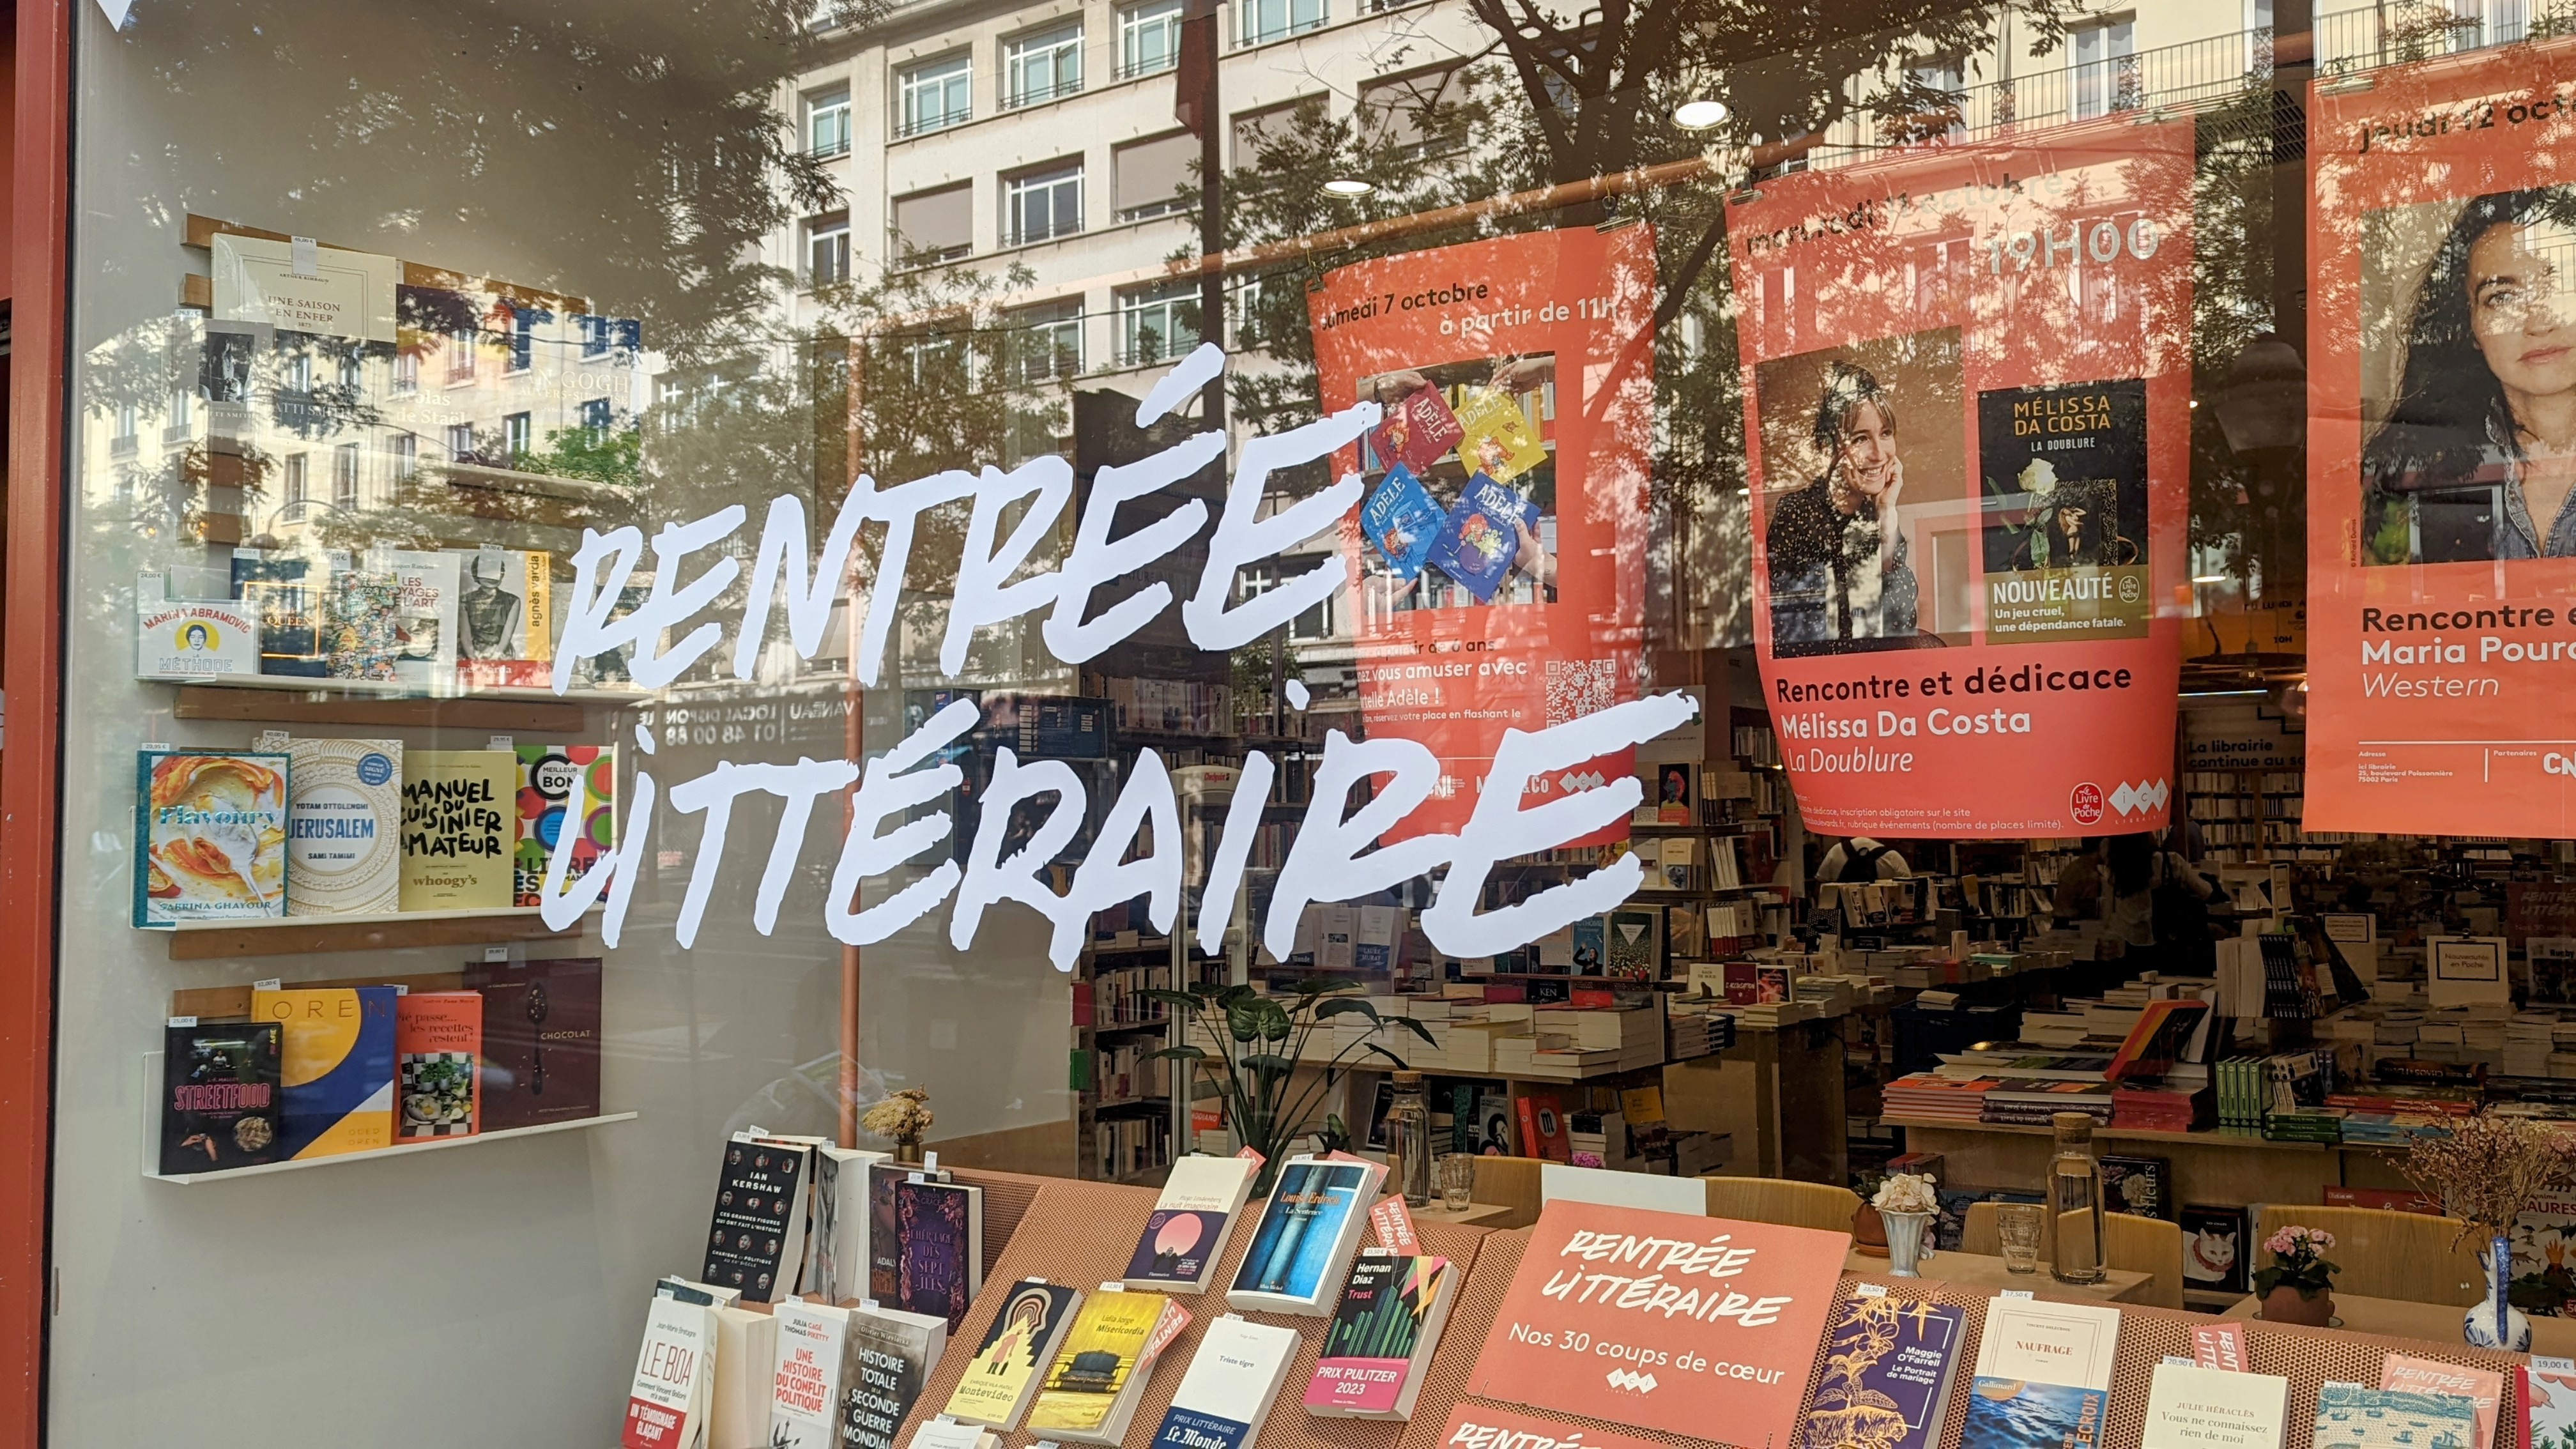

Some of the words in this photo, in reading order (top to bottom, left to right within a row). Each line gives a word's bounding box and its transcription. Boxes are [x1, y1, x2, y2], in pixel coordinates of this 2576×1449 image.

[1746, 199, 1874, 256] mercredi
[1984, 218, 2159, 275] 19H00
[268, 296, 293, 306] UNE
[297, 300, 341, 312] SAISON
[1384, 293, 1395, 314] 7
[1401, 282, 1489, 311] octobre
[275, 308, 291, 318] EN
[296, 311, 333, 322] ENFER
[1439, 313, 1453, 335] à
[1461, 303, 1532, 339] partir
[1539, 300, 1569, 323] de
[1577, 296, 1618, 321] 11h
[561, 370, 630, 394] GOGH
[2014, 395, 2111, 418] MÉLISSA
[1414, 397, 1448, 443] ADÈLE
[2015, 419, 2041, 436] DA
[2048, 413, 2112, 434] COSTA
[2031, 441, 2043, 452] LA
[2047, 437, 2096, 451] DOUBLURE
[1368, 476, 1406, 526] ADÈLE
[1474, 482, 1526, 524] ADÈLE
[551, 342, 1382, 697] RENTRÉE
[402, 577, 421, 586] LES
[1993, 572, 2113, 604] NOUVEAUTÉ
[143, 608, 187, 630] MARINA
[1995, 608, 2011, 618] Un
[2012, 608, 2030, 620] jeu
[2032, 606, 2065, 618] cruel,
[2363, 605, 2555, 632] Rencontre
[1995, 623, 2017, 632] une
[2018, 618, 2090, 632] dépendance
[2092, 617, 2126, 628] fatale.
[1466, 640, 1495, 652] ans
[2363, 637, 2465, 665] Maria
[159, 656, 233, 672] MÉTHODE
[1372, 667, 1400, 681] vous
[1406, 662, 1472, 679] amuser
[1478, 661, 1528, 676] avec
[1777, 674, 1910, 703] Rencontre
[1920, 671, 1952, 696] et
[1964, 664, 2131, 694] dédicace
[2363, 672, 2499, 698] Western
[1387, 688, 1429, 707] Adèle
[1399, 712, 1420, 721] votre
[1422, 710, 1446, 721] place
[1463, 709, 1508, 719] flashant
[1512, 709, 1521, 717] le
[1781, 710, 1867, 740] Mélissa
[1877, 710, 1917, 737] Da
[1927, 708, 2031, 736] Costa
[2189, 740, 2206, 753] La
[2212, 739, 2273, 752] librairie
[1788, 749, 1805, 772] La
[1810, 747, 1913, 773] Doublure
[2189, 755, 2259, 767] continue
[2264, 756, 2284, 766] au
[443, 800, 464, 814] DU
[1880, 808, 1924, 818] obligatoire
[2074, 808, 2100, 818] Poche
[289, 818, 374, 839] JERUSALEM
[1879, 820, 1931, 829] événements
[1933, 820, 1972, 831] (nombre
[1975, 820, 1987, 829] de
[1990, 820, 2025, 831] places
[413, 874, 477, 887] whoogy's
[160, 901, 210, 911] SABRINA
[215, 901, 271, 910] GHAYOUR
[1540, 988, 1557, 998] KEN
[272, 999, 386, 1020] OREN
[541, 1029, 591, 1040] CHOCOLAT
[174, 1083, 270, 1110] STREETFOOD
[749, 1171, 768, 1181] IAN
[732, 1179, 781, 1193] KERSHAW
[1560, 1230, 1756, 1278] RENTRÉE
[1356, 1263, 1392, 1273] Hernan
[1352, 1275, 1374, 1285] Diaz
[1348, 1289, 1373, 1300] Trust
[785, 1325, 806, 1337] THOMAS
[1096, 1324, 1144, 1336] Misericordia
[795, 1347, 813, 1363] UNE
[1508, 1321, 1553, 1347] Nos
[1558, 1330, 1591, 1353] 30
[1595, 1342, 1669, 1368] coups
[1675, 1349, 1706, 1373] de
[1713, 1360, 1786, 1386] cœur
[1905, 1346, 1942, 1360] Maggie
[2015, 1340, 2073, 1356] NAUFRAGE
[641, 1339, 665, 1378] LE
[663, 1346, 694, 1387] BOA
[859, 1347, 904, 1373] HISTOIRE
[1219, 1355, 1238, 1365] Triste
[1239, 1359, 1255, 1368] tigre
[1897, 1354, 1941, 1367] O'Farrell
[2167, 1358, 2188, 1367] 20,90
[2537, 1361, 2561, 1369] 19,00
[783, 1360, 823, 1382] HISTOIRE
[861, 1367, 896, 1391] TOTALE
[1316, 1366, 1344, 1379] PRIX
[1344, 1368, 1397, 1384] PULITZER
[1899, 1372, 1935, 1385] mariage
[1904, 1366, 1937, 1377] Portrait
[2392, 1365, 2477, 1390] RENTRÉE
[776, 1372, 788, 1387] DU
[790, 1377, 826, 1399] CONFLIT
[1335, 1382, 1365, 1395] 2023
[1978, 1379, 2016, 1391] Gallimard
[776, 1388, 823, 1413] POLITIQUE
[851, 1388, 900, 1416] SECONDE
[958, 1386, 1014, 1402] Montevideo
[640, 1404, 677, 1430] TÉMOIGNAGE
[2177, 1402, 2204, 1412] JULIE
[2205, 1405, 2255, 1418] HÉRACLÈS
[853, 1409, 893, 1434] GUERRE
[1173, 1414, 1192, 1424] PRIX
[1192, 1418, 1236, 1435] LITTÉRAIRE
[2162, 1411, 2188, 1423] Vous
[2191, 1416, 2205, 1425] ne
[2207, 1419, 2268, 1434] connaissez
[1179, 1428, 1227, 1449] Monde
[2179, 1428, 2198, 1438] rien
[2205, 1430, 2219, 1441] de
[2222, 1435, 2244, 1445] moi
